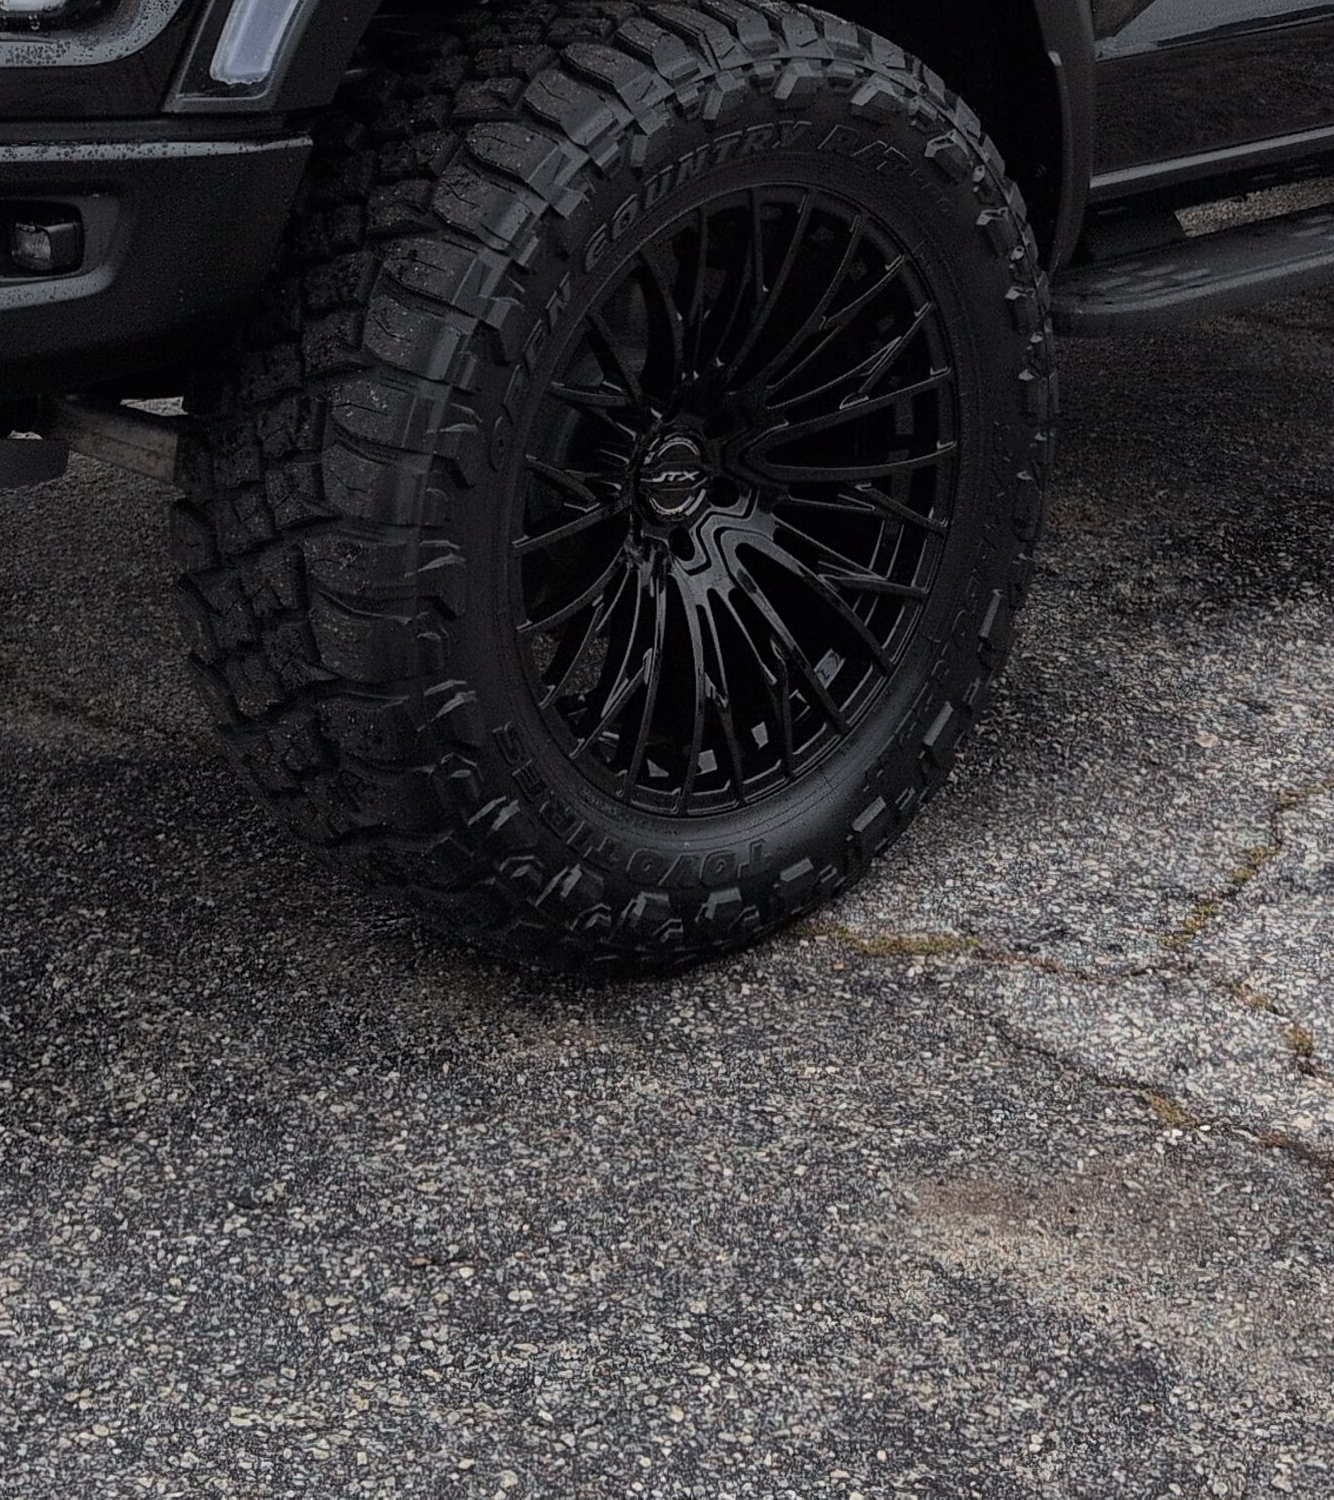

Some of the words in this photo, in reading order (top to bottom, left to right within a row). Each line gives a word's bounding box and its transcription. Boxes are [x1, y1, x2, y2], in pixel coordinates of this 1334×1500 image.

[584, 119, 812, 274] COUNTRY
[639, 470, 701, 483] JTX
[492, 720, 620, 873] TIRES
[625, 838, 766, 888] TOYO
